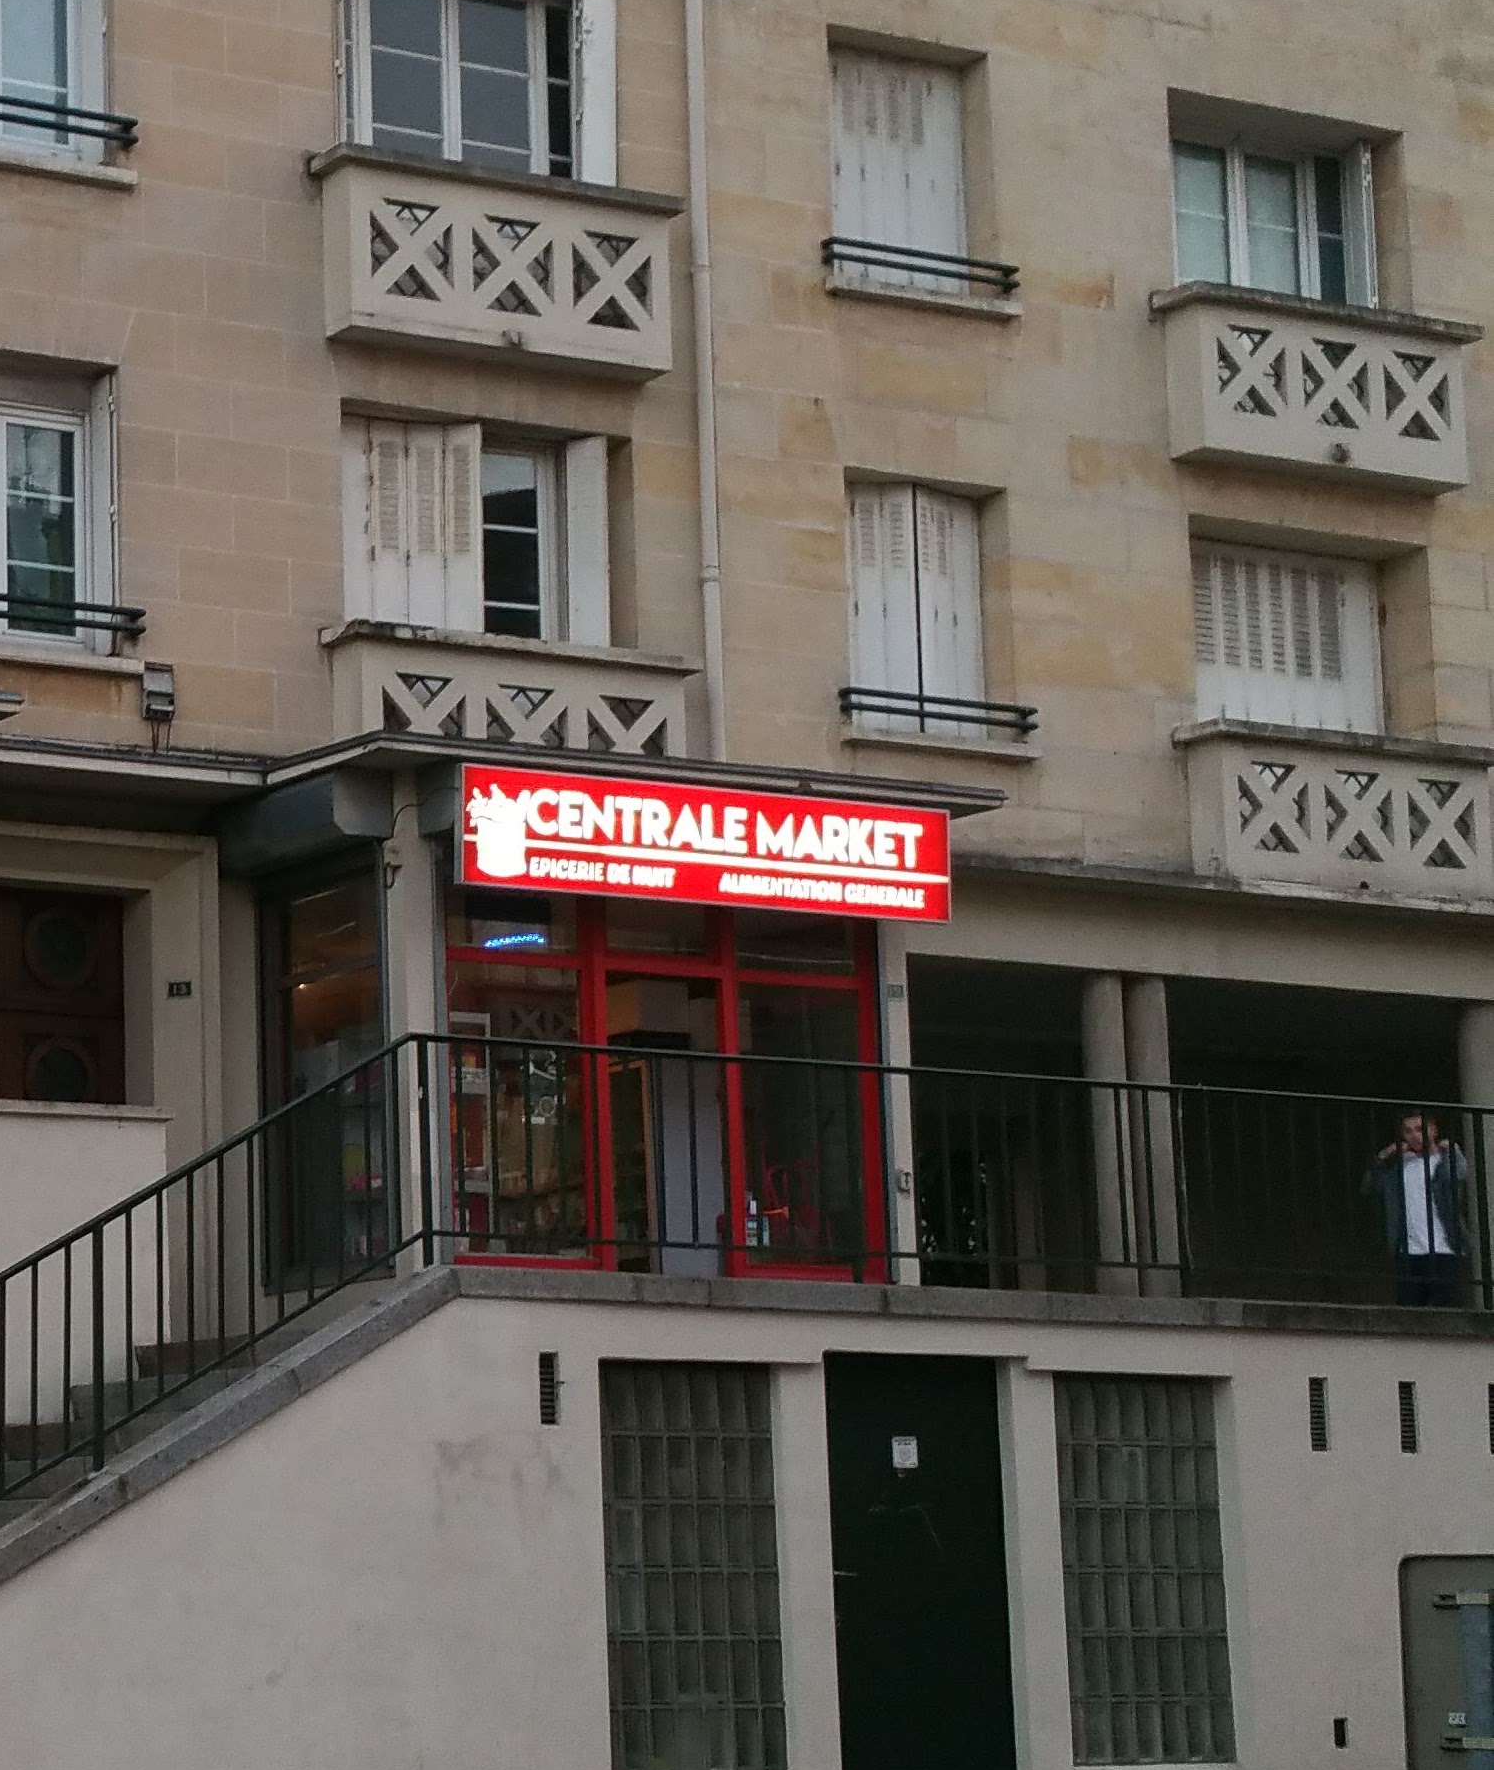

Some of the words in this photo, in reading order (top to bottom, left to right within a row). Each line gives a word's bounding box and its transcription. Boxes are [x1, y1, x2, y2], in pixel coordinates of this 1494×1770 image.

[527, 788, 748, 854] CENTRALE
[757, 809, 924, 868] MARKET
[529, 857, 605, 882] EPICERIE
[606, 863, 631, 885] DE
[632, 865, 676, 888] NUIT
[719, 872, 843, 901] ALIMENTATION
[844, 883, 926, 909] GENERALE
